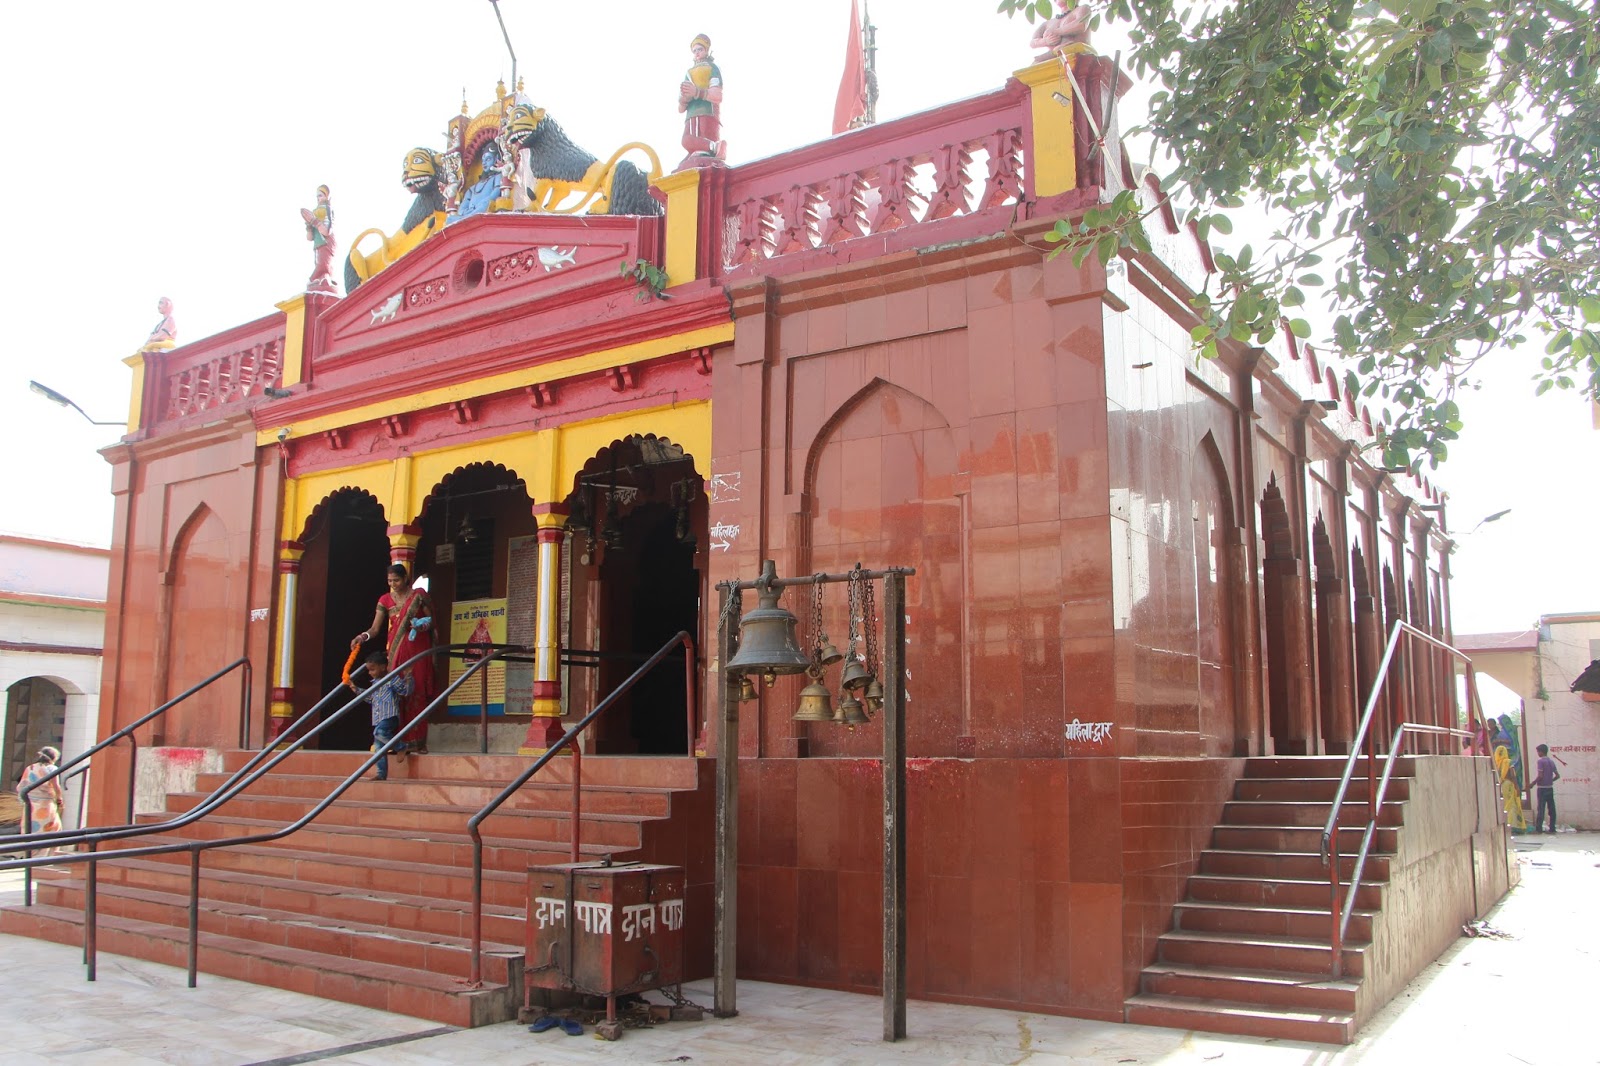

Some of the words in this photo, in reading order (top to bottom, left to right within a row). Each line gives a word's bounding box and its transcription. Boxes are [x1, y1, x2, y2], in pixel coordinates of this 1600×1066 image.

[535, 897, 566, 929] दान
[574, 900, 613, 935] पात्र
[621, 903, 656, 942] दान
[658, 899, 684, 931] पात्र
